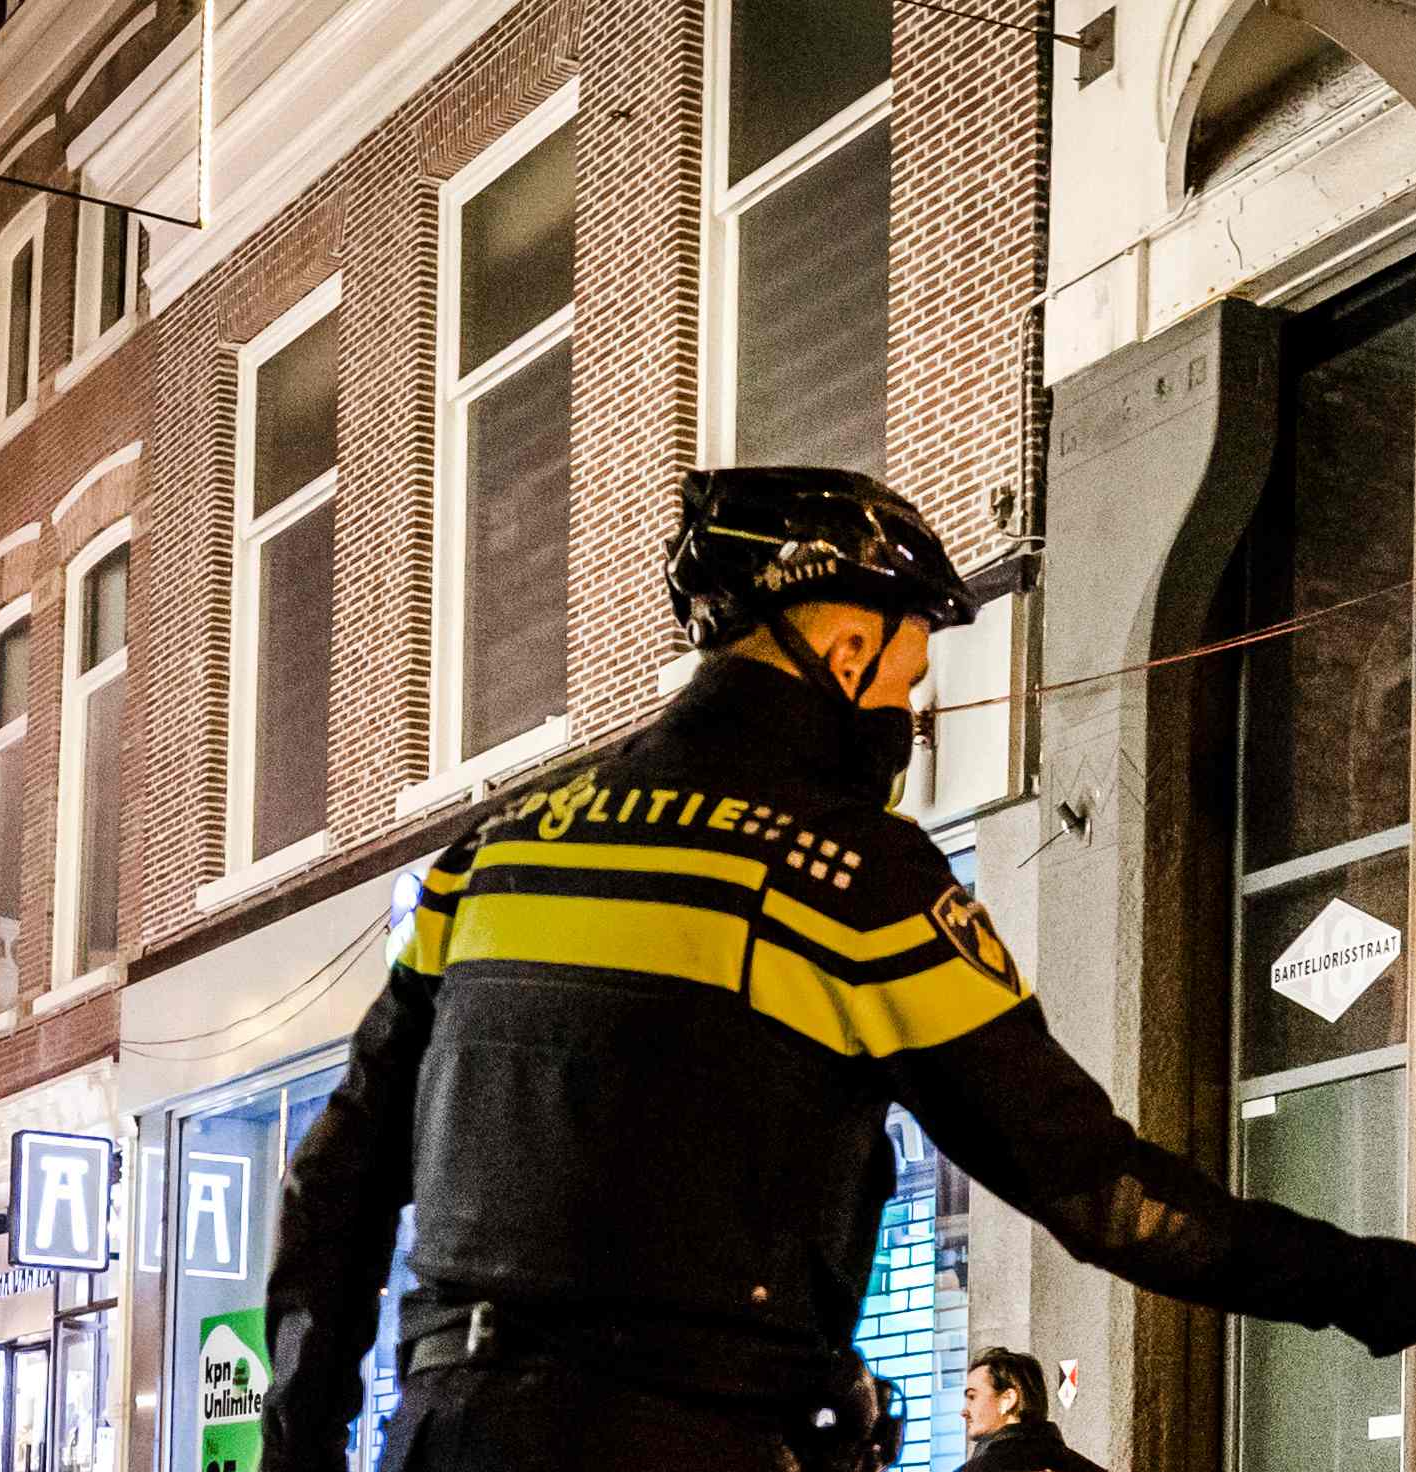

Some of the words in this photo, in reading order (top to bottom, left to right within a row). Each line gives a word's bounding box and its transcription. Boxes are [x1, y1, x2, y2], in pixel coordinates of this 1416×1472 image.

[1274, 936, 1397, 983] BARTELJORISSTRAAT
[205, 1356, 231, 1389] kpn
[204, 1389, 262, 1420] Unlimite
